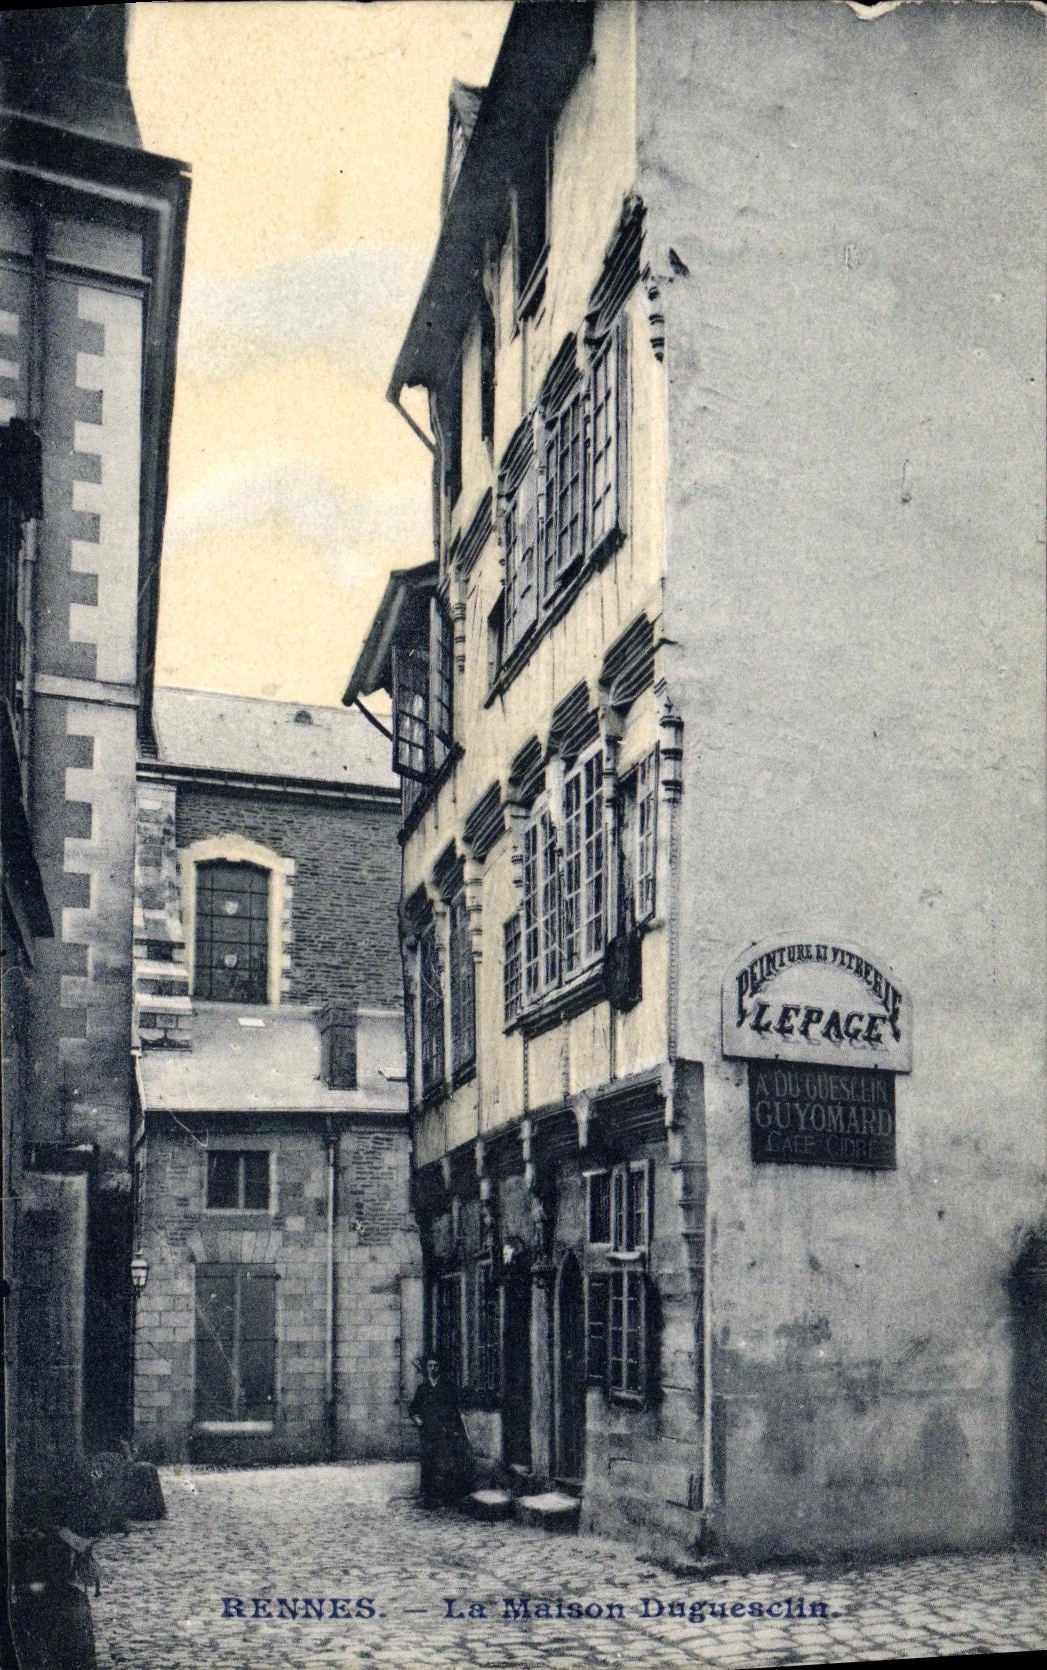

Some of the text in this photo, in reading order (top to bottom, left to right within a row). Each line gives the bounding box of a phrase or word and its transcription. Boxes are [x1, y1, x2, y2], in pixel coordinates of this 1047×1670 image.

[736, 944, 902, 1043] PEINTURE ET VITRERIE
[751, 1001, 888, 1044] LEPAGE
[774, 1069, 802, 1098] DU
[804, 1072, 888, 1104] GUESCLIN
[754, 1100, 893, 1137] GUYOMARD
